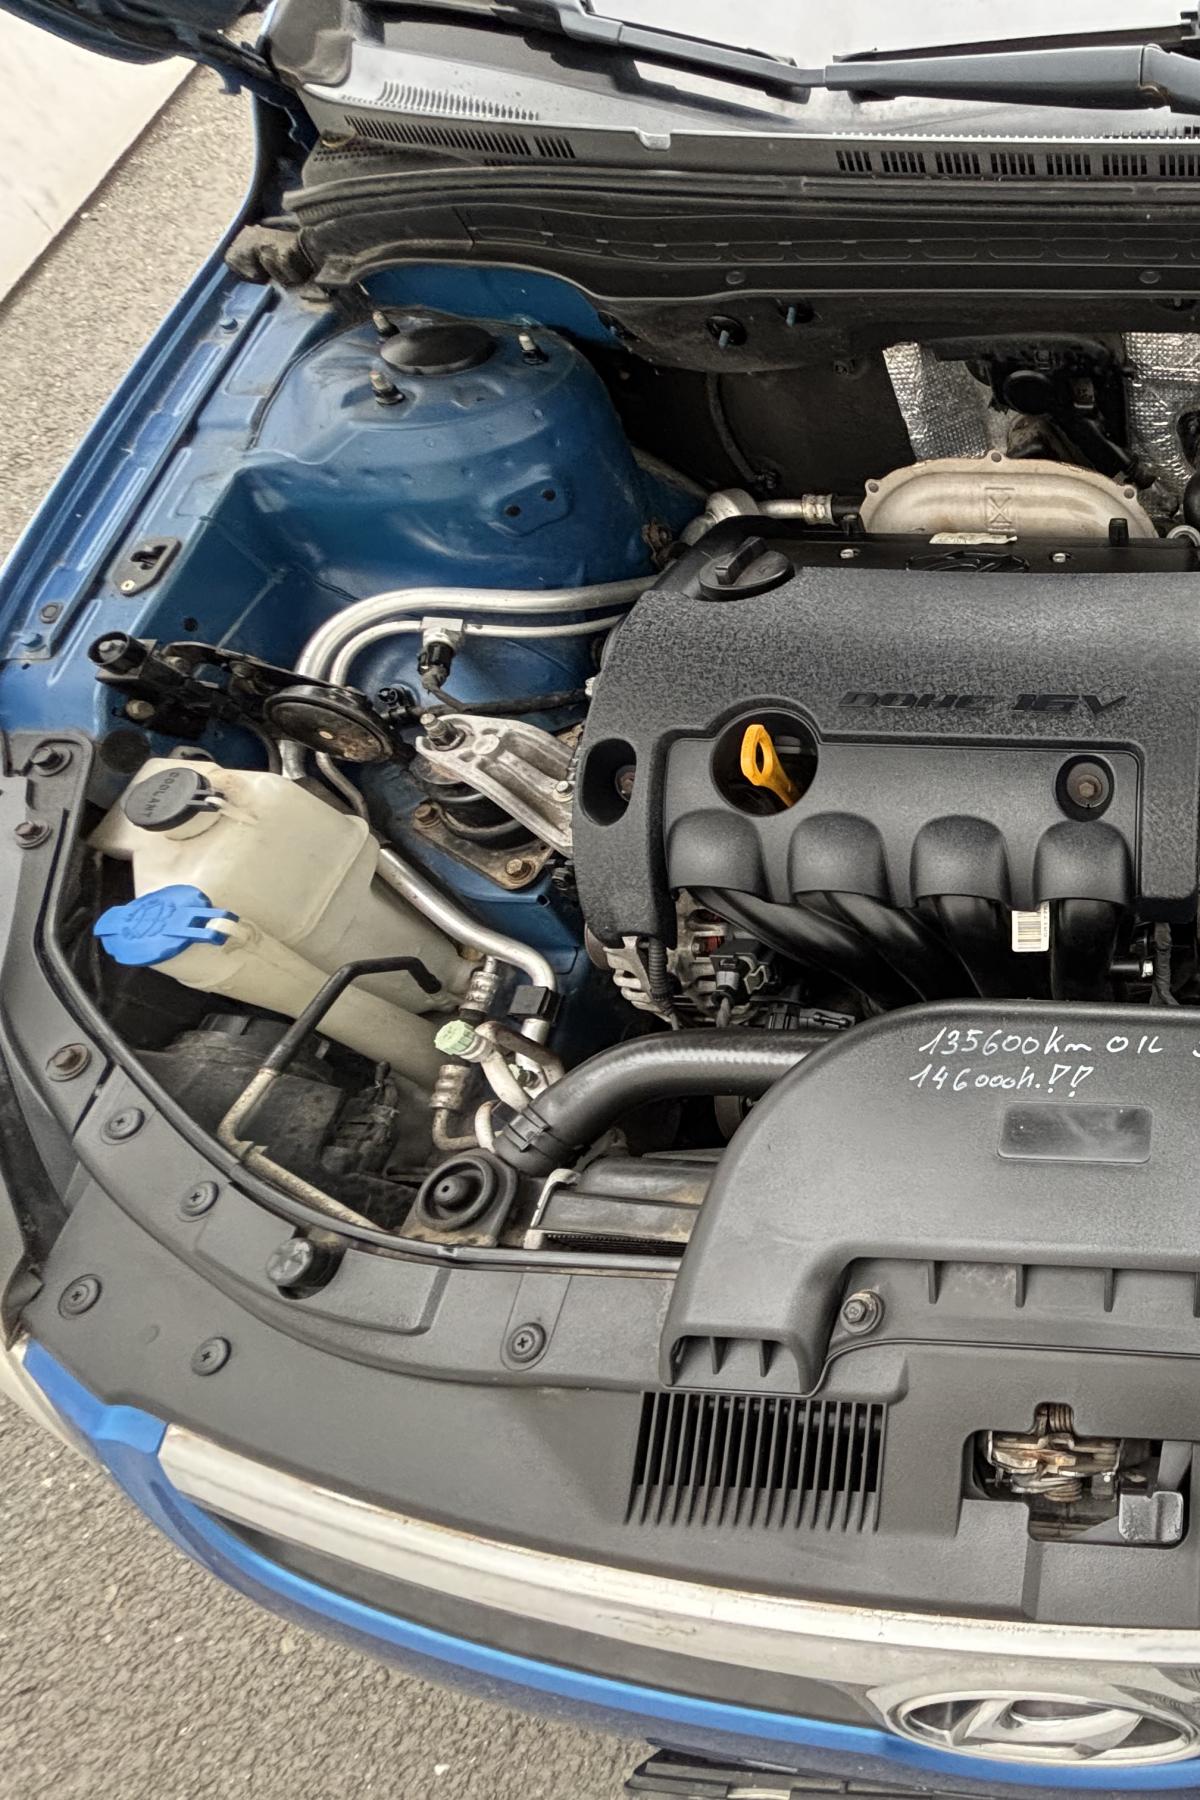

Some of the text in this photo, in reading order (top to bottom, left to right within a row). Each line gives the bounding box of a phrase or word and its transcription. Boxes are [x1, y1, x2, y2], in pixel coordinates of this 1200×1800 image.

[838, 690, 1127, 714] DOHC 16V
[143, 772, 180, 818] COOLANT
[1105, 1034, 1165, 1055] OIL
